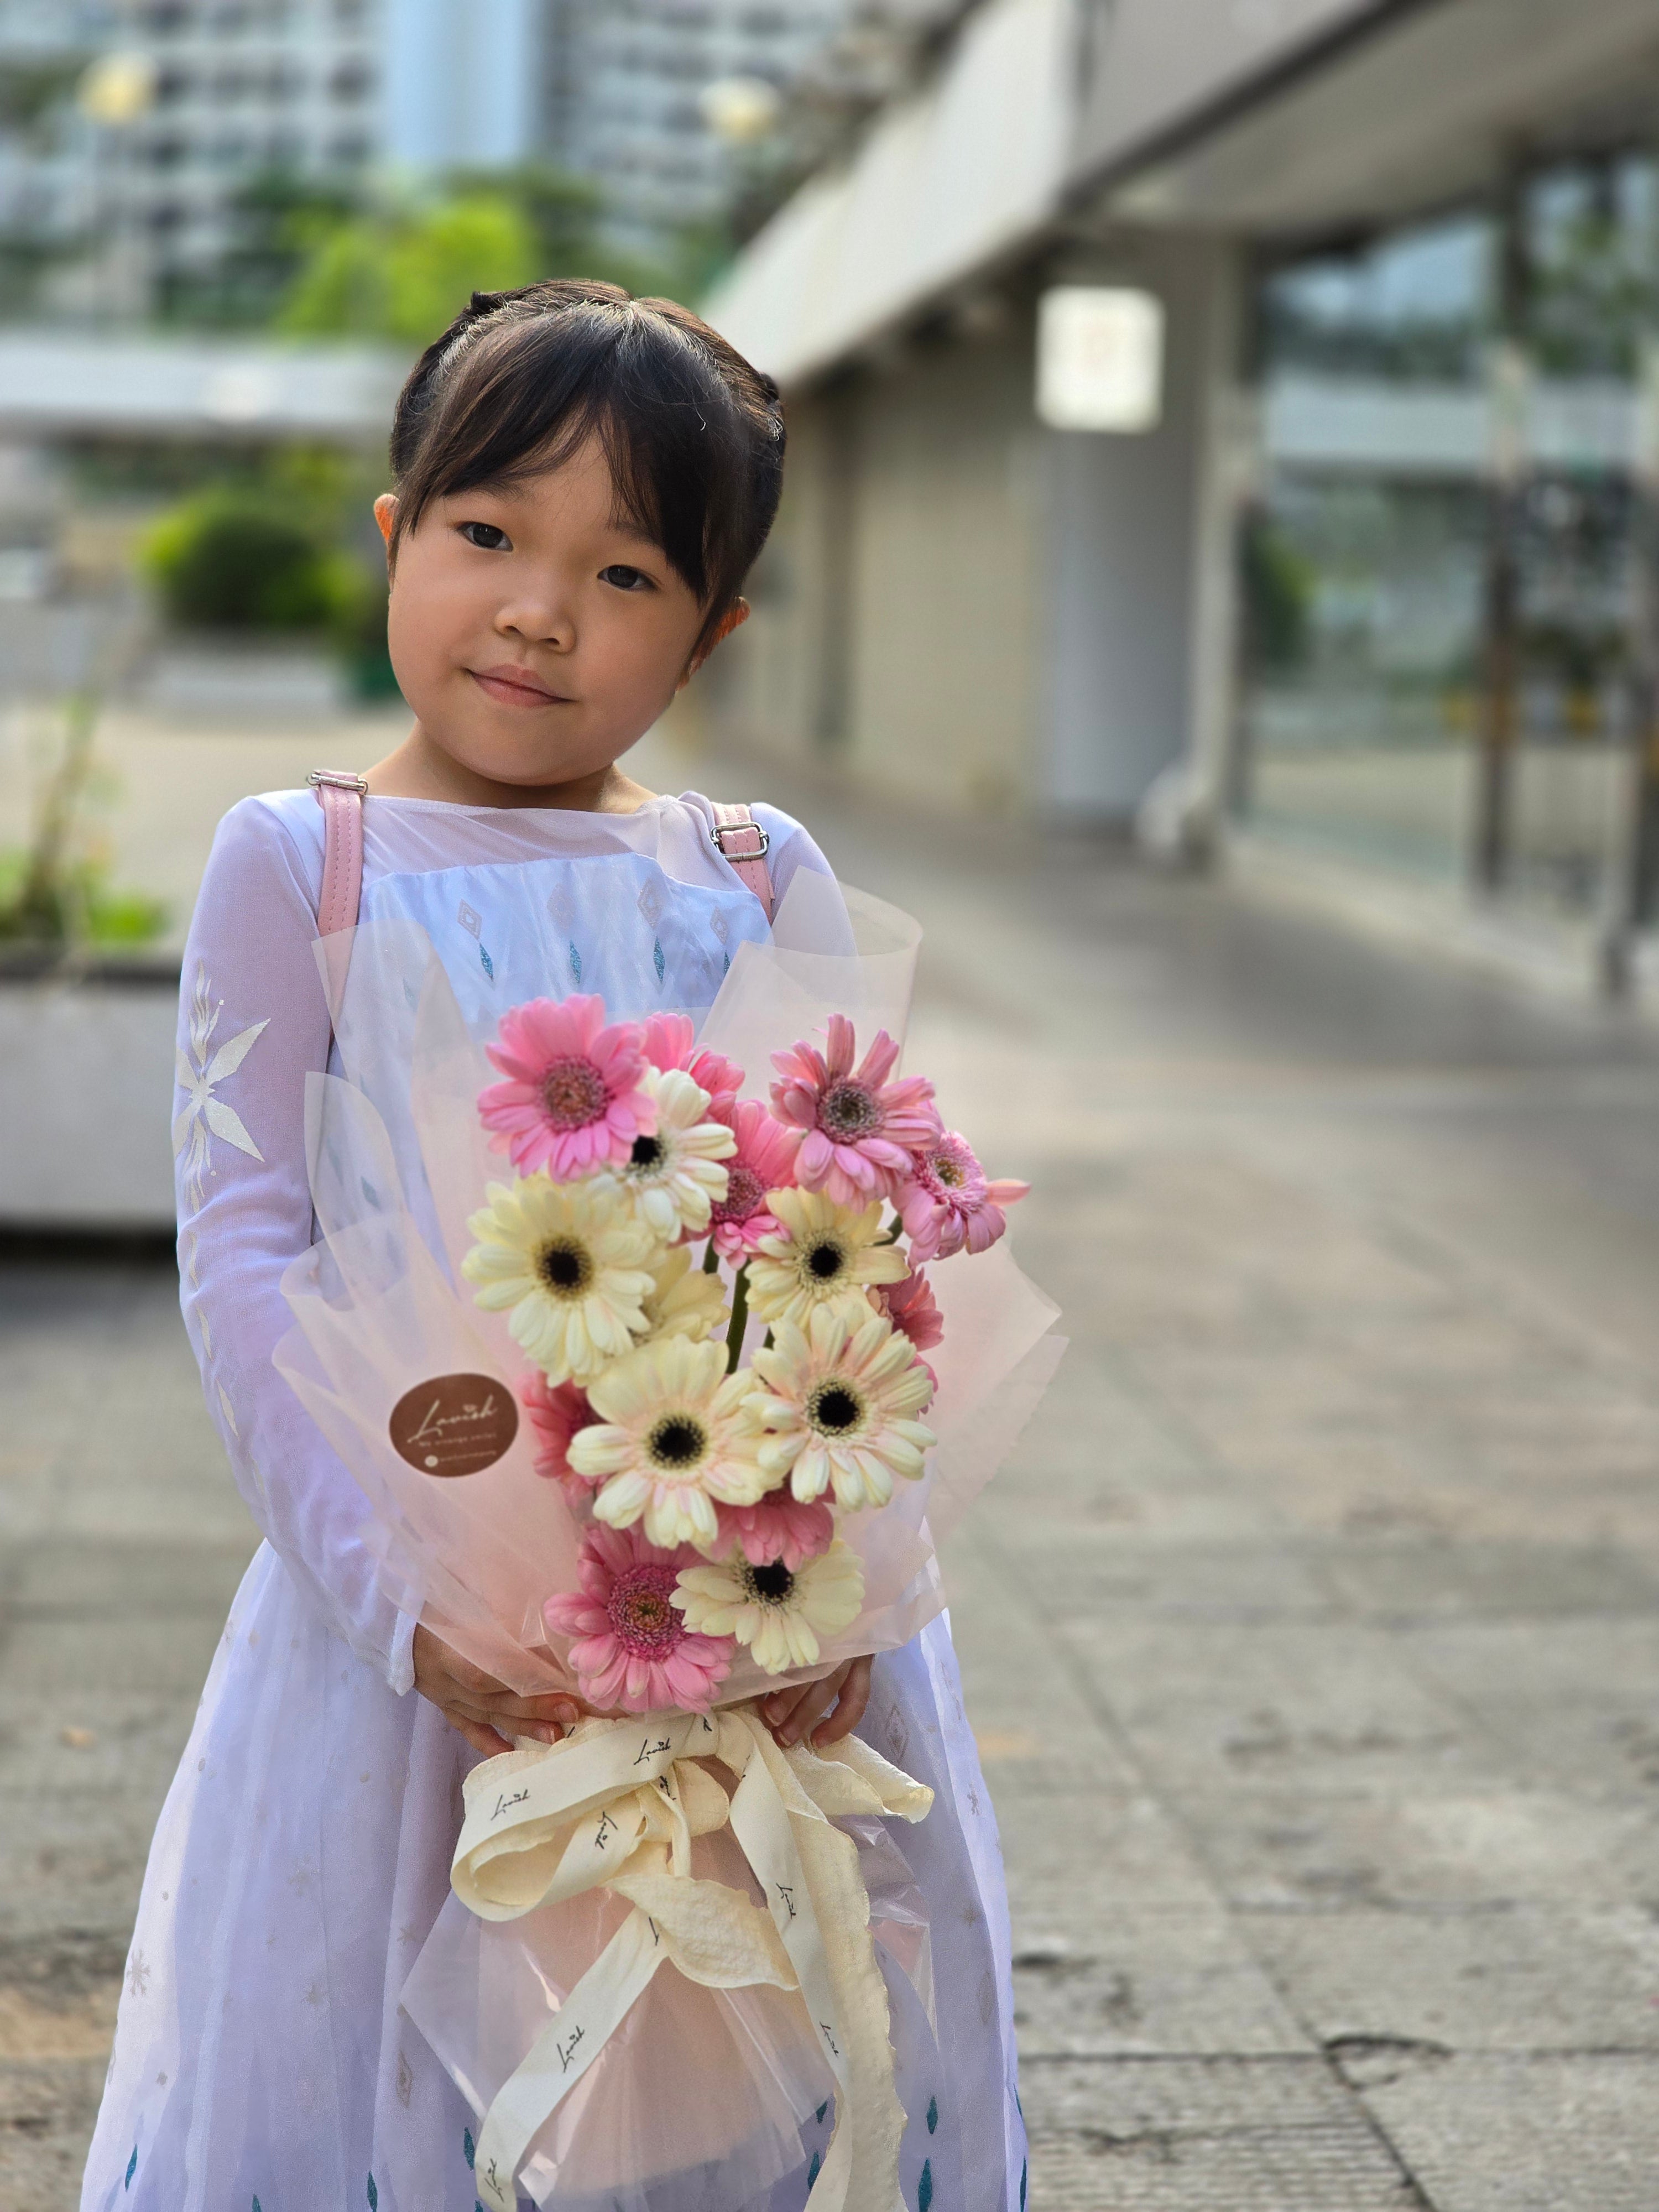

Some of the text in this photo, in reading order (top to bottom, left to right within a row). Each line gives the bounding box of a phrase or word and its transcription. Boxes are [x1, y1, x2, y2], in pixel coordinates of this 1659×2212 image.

[407, 1394, 498, 1443] Lavish
[633, 1737, 671, 1766] Lavish
[490, 1788, 531, 1821] Lavish
[594, 1811, 618, 1850] Lavish
[556, 2025, 585, 2073] Lavish
